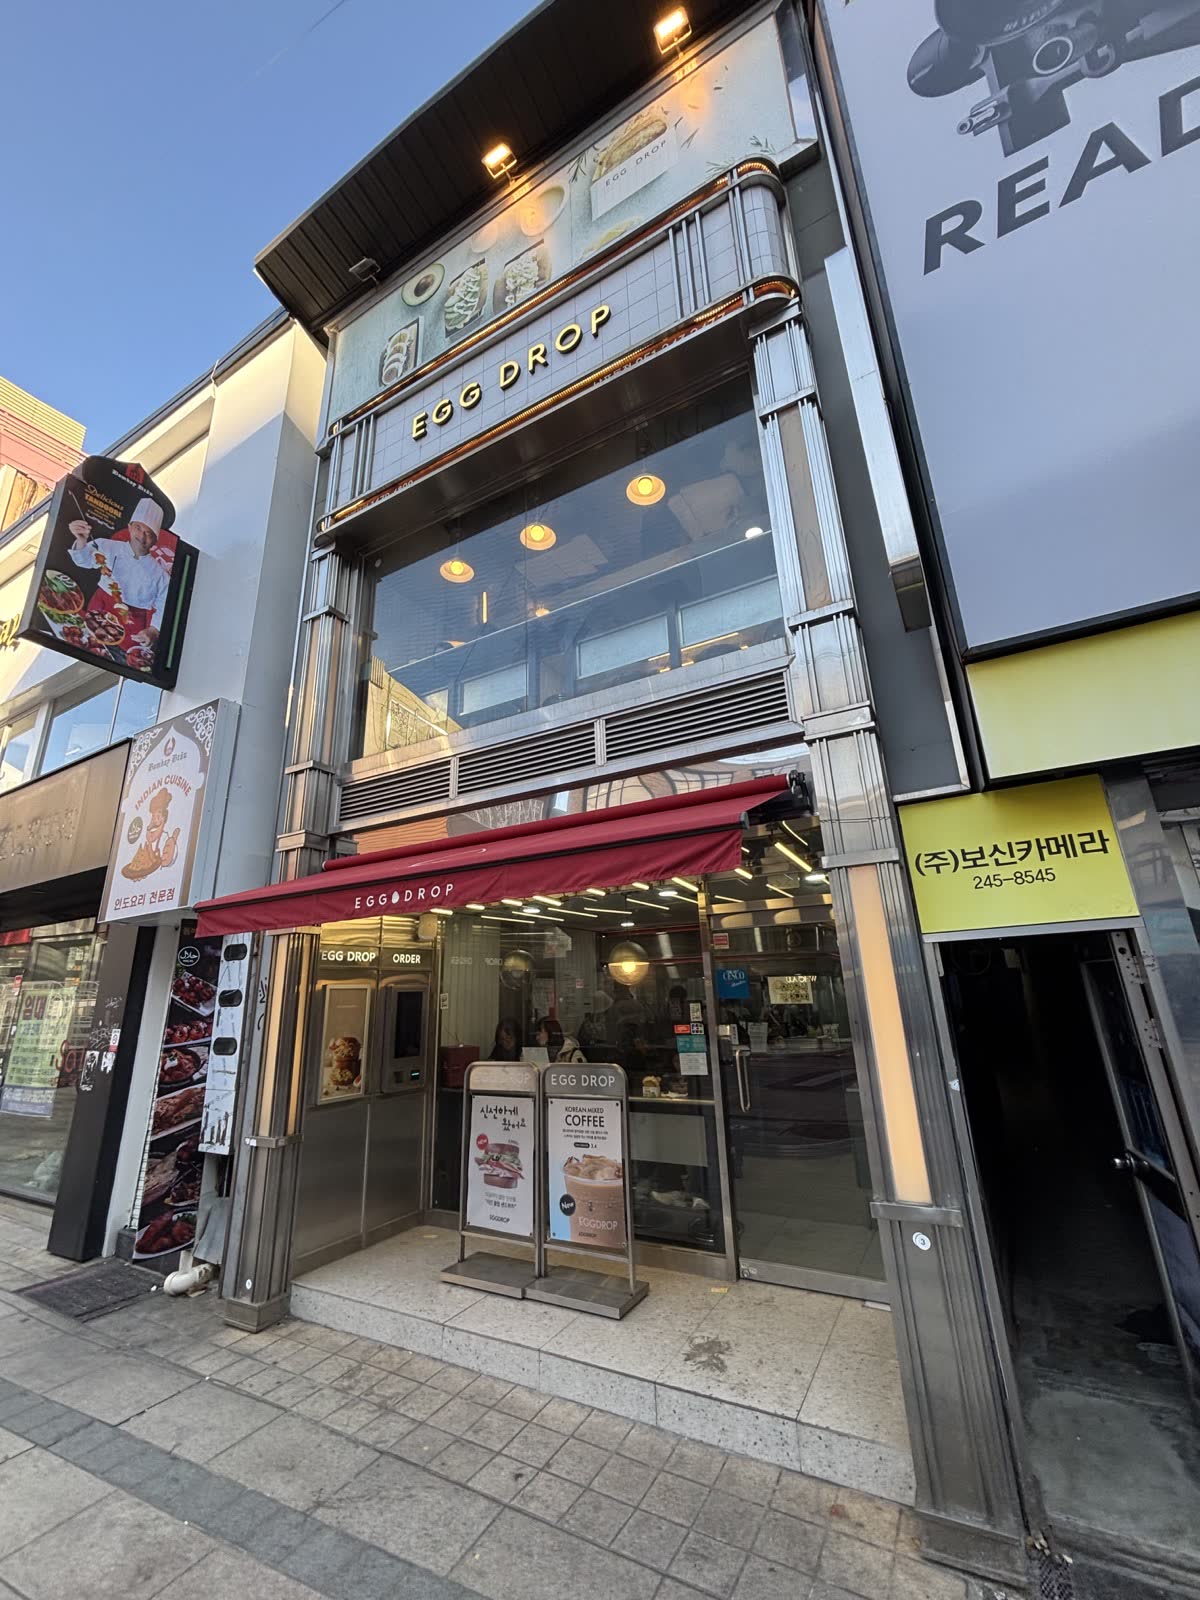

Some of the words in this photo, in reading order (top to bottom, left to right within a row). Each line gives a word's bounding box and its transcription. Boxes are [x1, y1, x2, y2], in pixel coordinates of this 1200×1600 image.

[605, 167, 627, 187] EGG
[411, 382, 483, 441] EGG
[499, 304, 611, 390] DROP
[84, 493, 123, 519] TANDOORI
[135, 777, 163, 811] INDIAN
[164, 774, 192, 797] CUISINE
[915, 829, 1110, 876] (주)보신카메라
[972, 867, 1057, 890] 245-8545
[113, 893, 147, 911] 인도요리
[149, 887, 176, 905] 전문점
[354, 893, 388, 909] EGG
[404, 883, 454, 902] DROP
[321, 950, 344, 961] EGG
[346, 951, 376, 962] DROP
[392, 953, 421, 964] ORDER
[551, 1074, 577, 1086] EGG
[581, 1074, 615, 1087] DROP
[565, 1114, 605, 1128] COFFEE
[579, 1216, 618, 1231] EGGDROP
